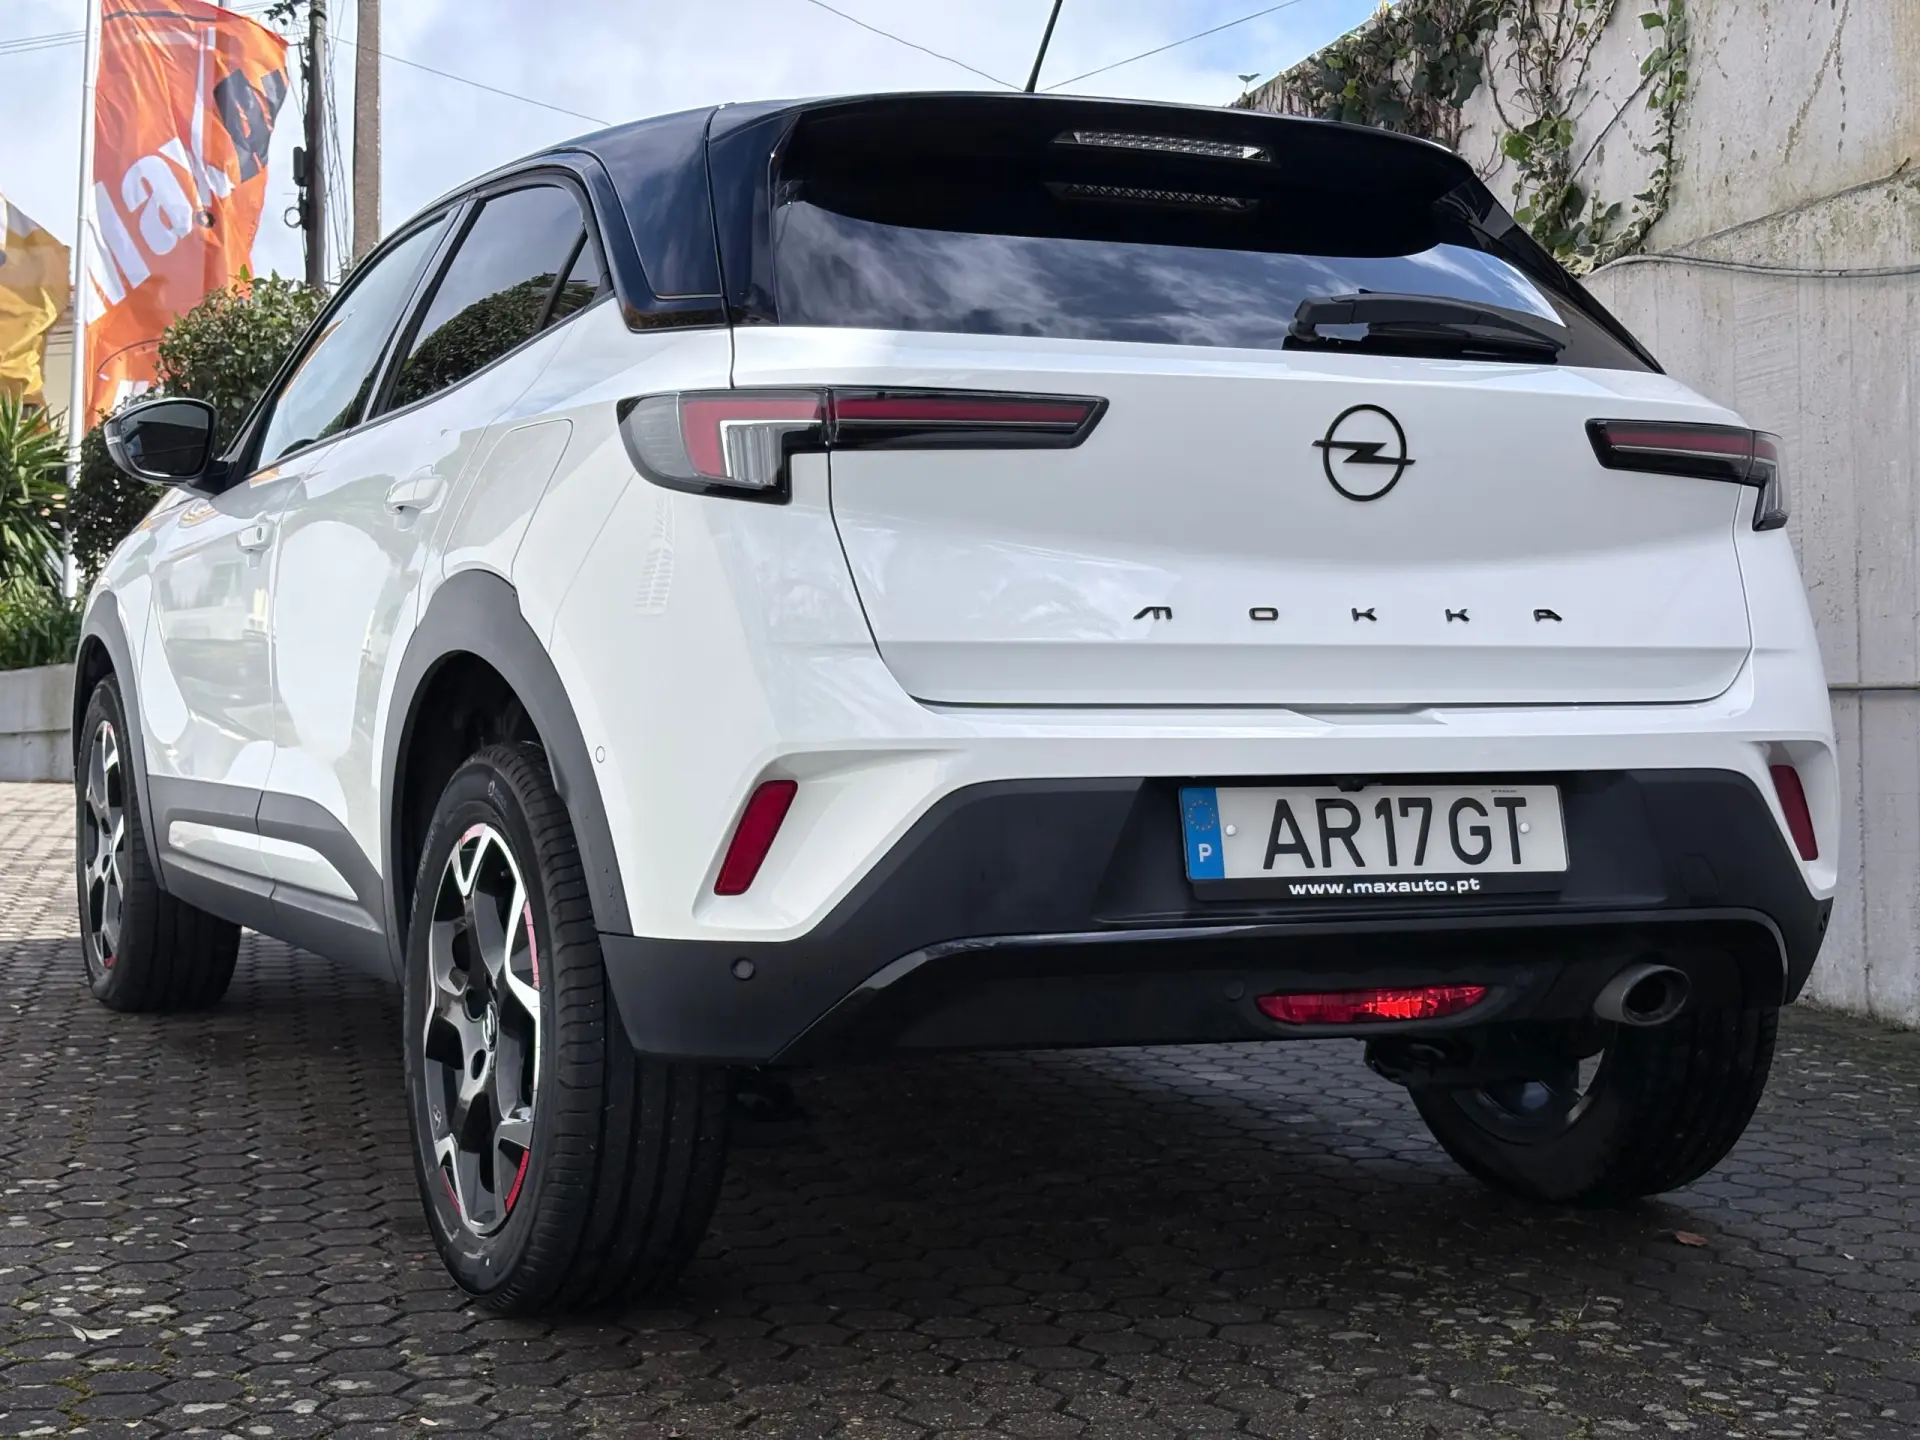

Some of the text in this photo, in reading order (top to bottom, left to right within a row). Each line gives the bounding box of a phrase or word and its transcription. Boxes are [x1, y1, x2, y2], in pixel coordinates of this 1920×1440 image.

[1133, 606, 1563, 622] MOKKA
[1198, 843, 1212, 863] P
[1288, 877, 1481, 896] www.maxauto.pt
